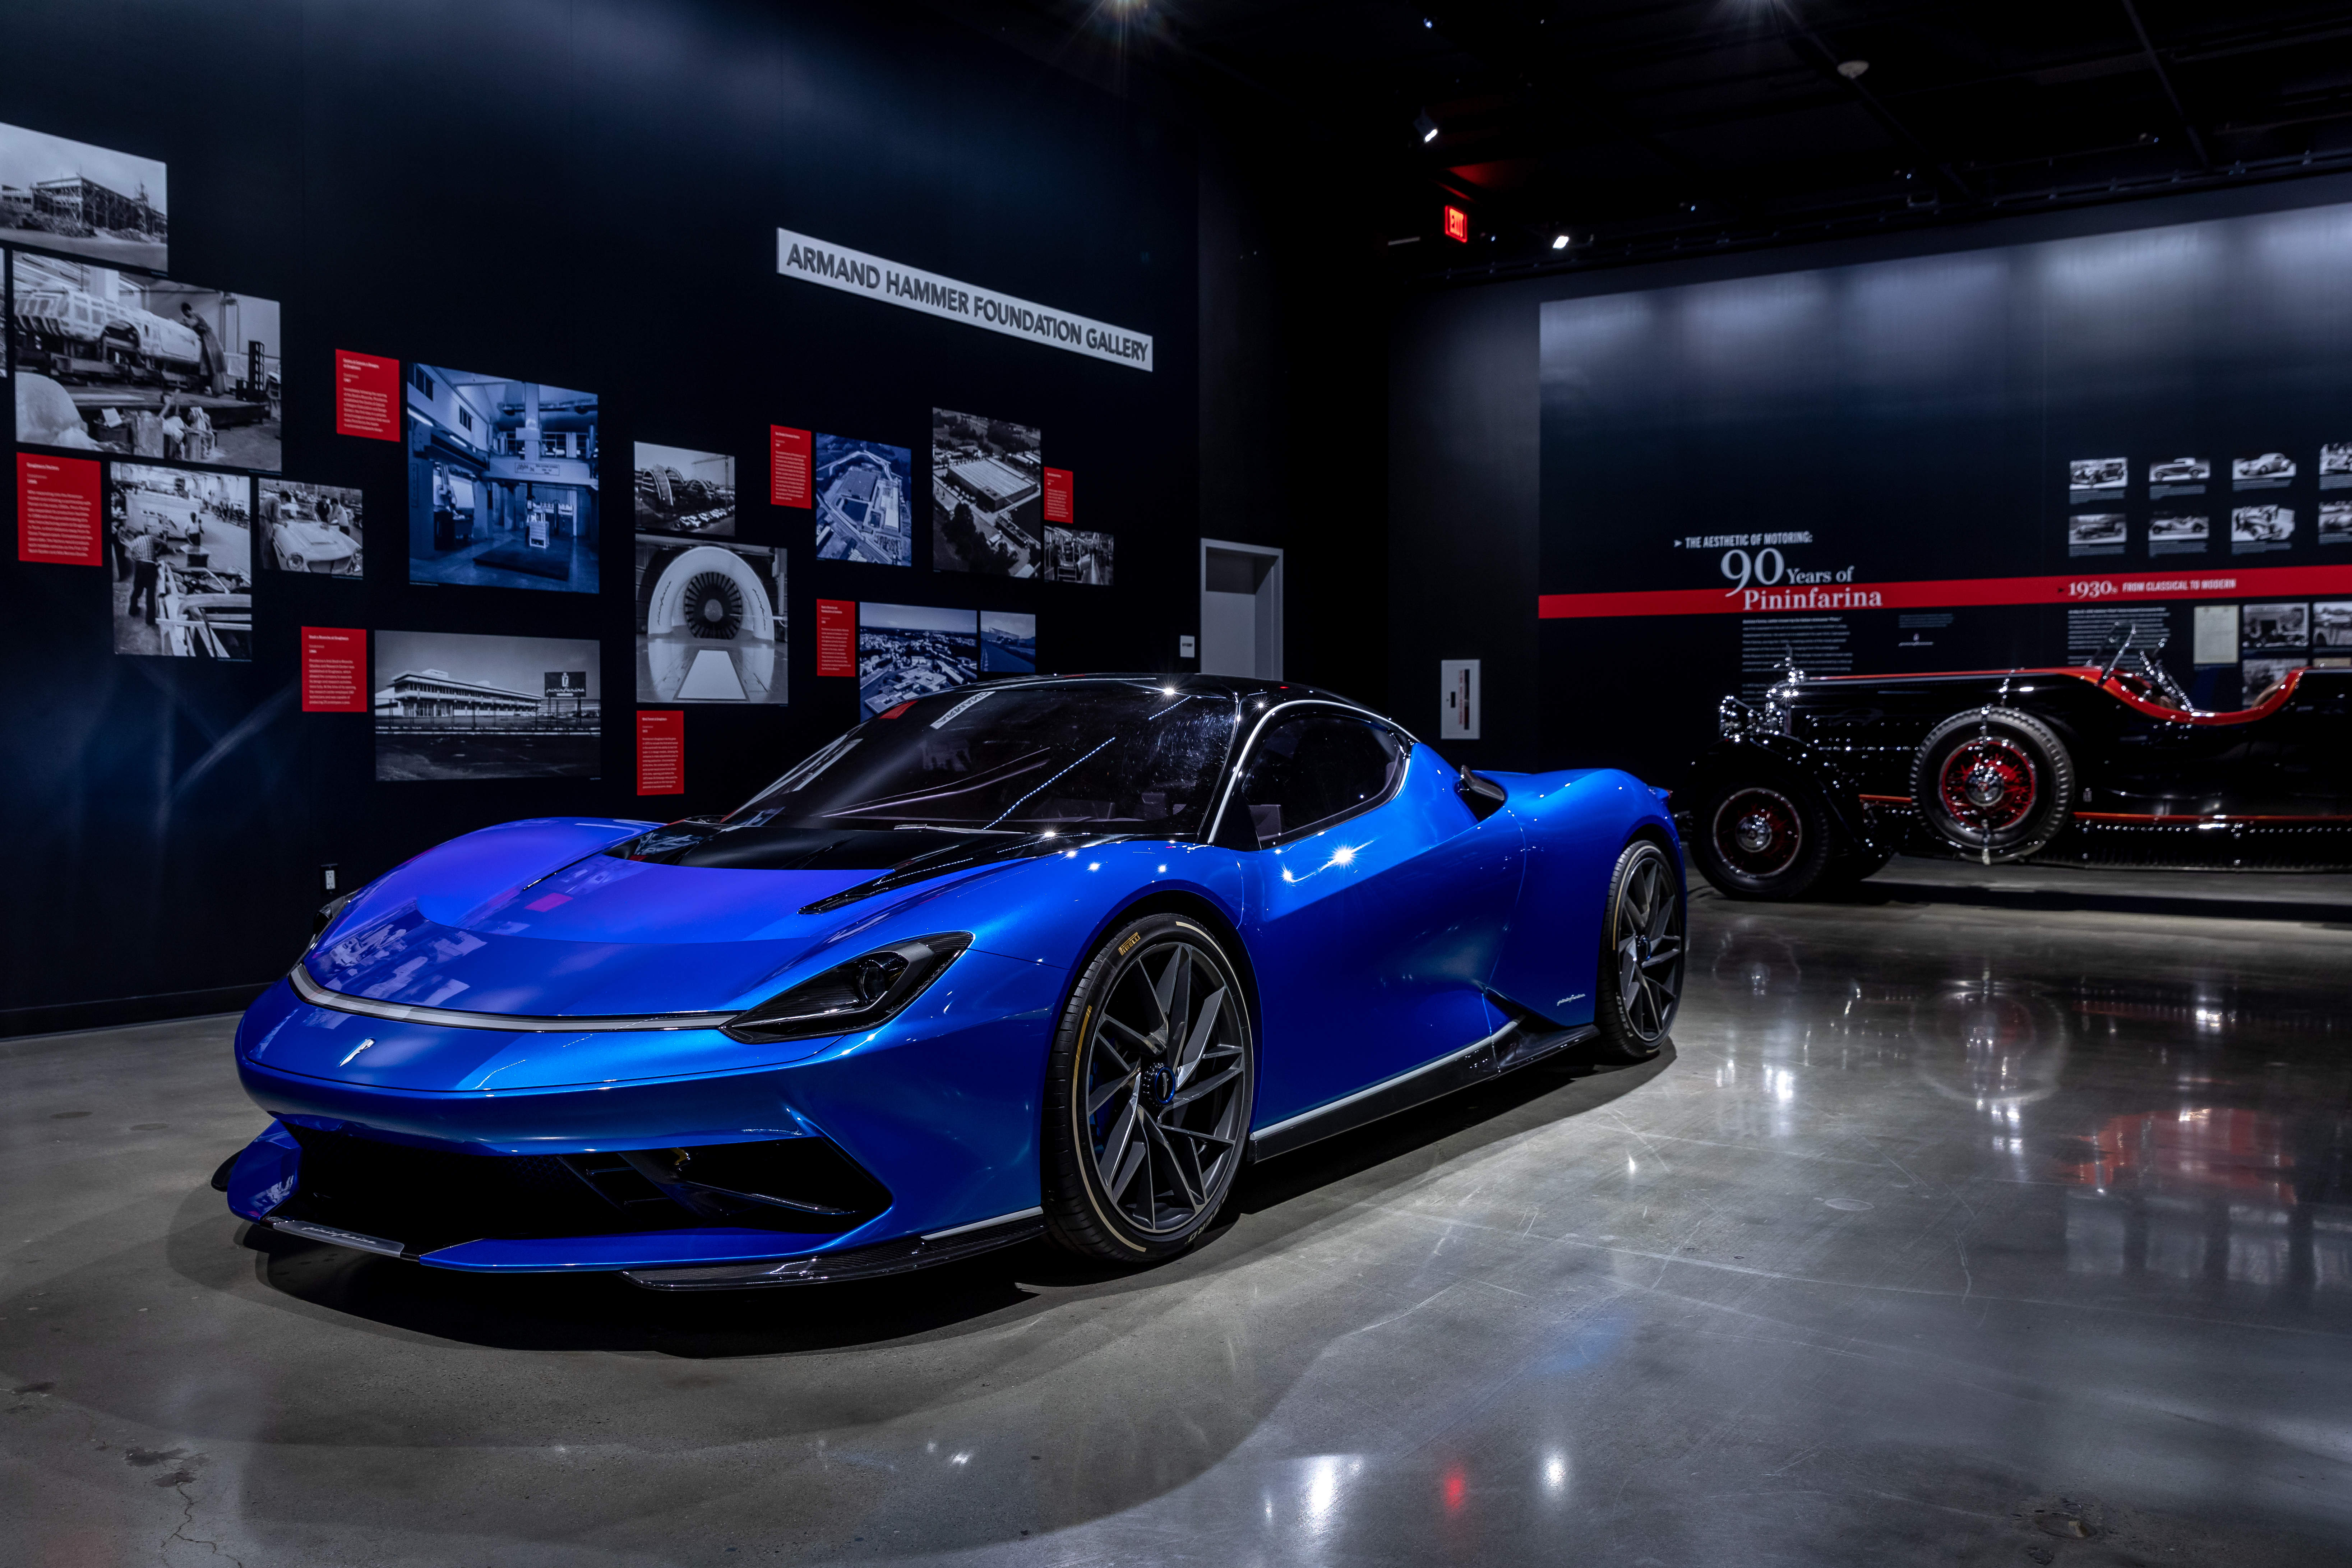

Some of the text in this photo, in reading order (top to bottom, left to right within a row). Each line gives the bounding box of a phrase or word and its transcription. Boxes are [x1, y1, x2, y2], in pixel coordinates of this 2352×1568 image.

[787, 243, 1148, 362] ARMAND HAMMER FOUNDATION GALLERY
[1685, 531, 1813, 549] THE AESTHETIC OF MOTORING:
[1720, 547, 1855, 597] 90 Years of
[1743, 587, 1883, 611] Pininfarina
[2068, 578, 2237, 599] 1930s FROM CLASSICAL TO MODERN
[1118, 931, 1141, 956] PIRELLI
